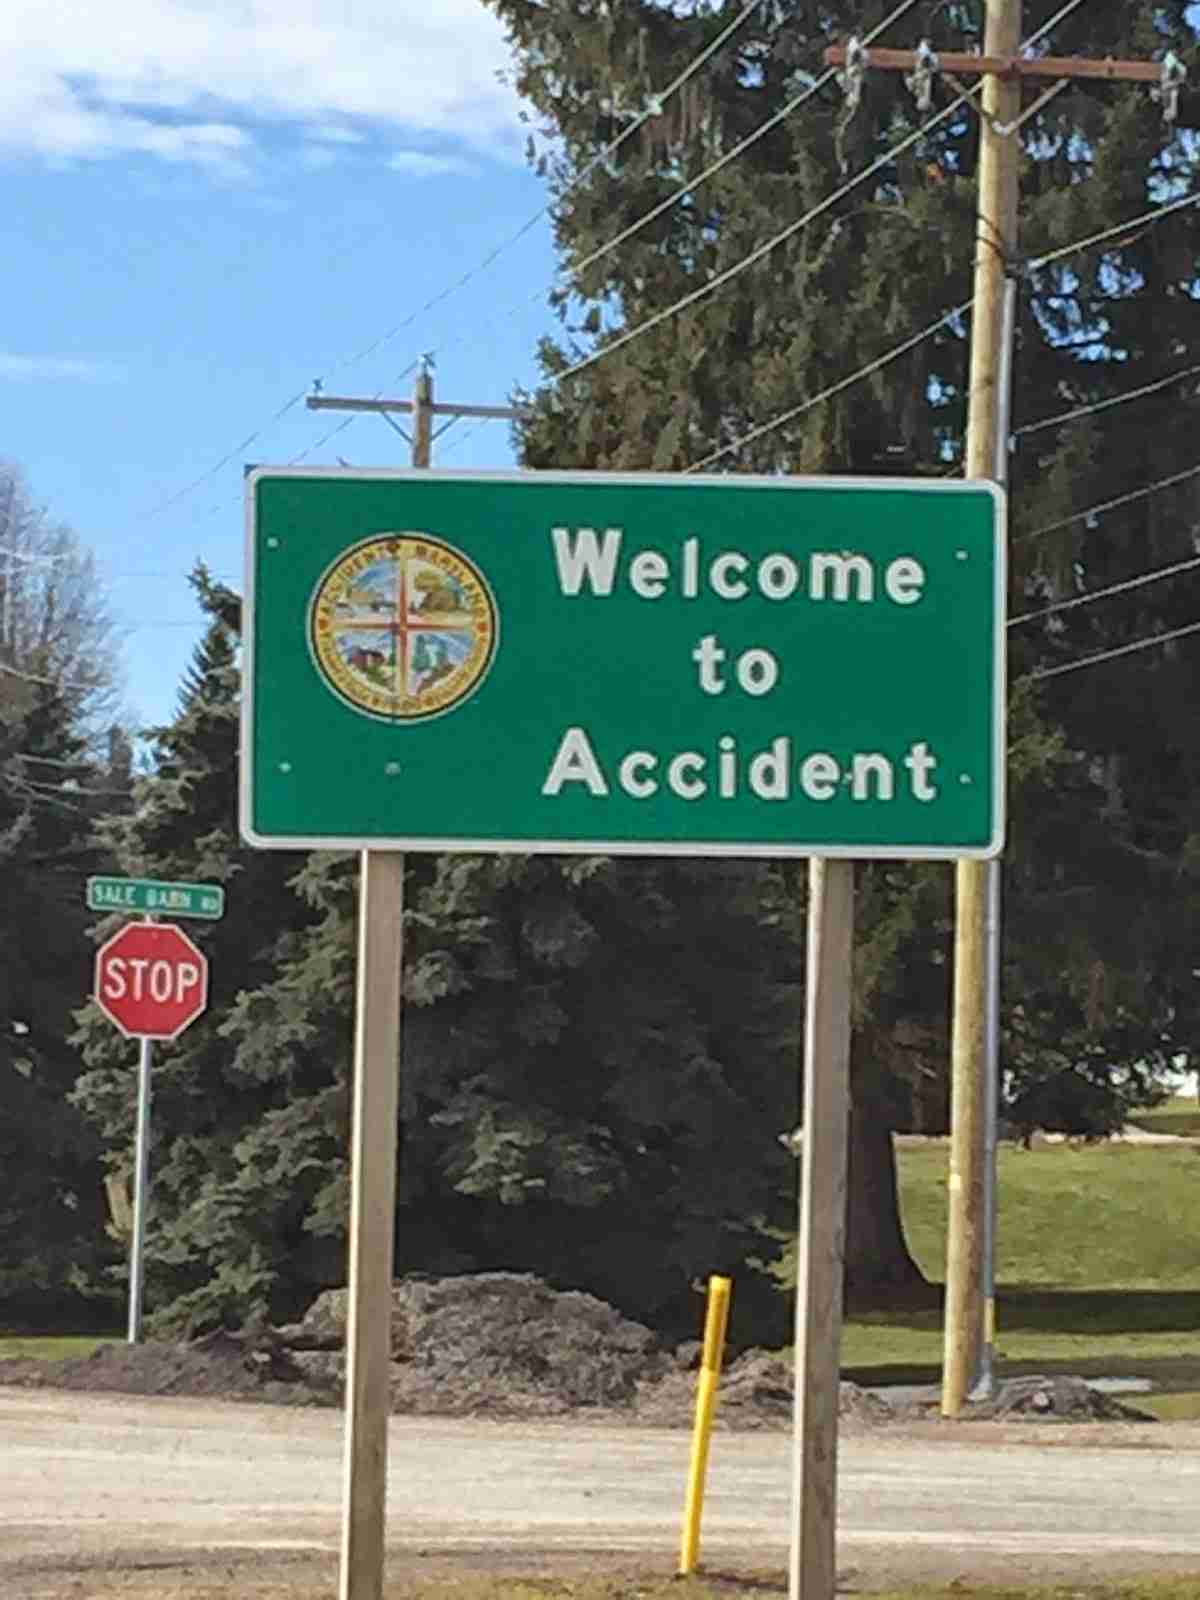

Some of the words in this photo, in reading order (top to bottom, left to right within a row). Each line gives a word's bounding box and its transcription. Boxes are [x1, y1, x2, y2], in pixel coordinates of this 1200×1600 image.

[552, 528, 925, 604] Welcome
[693, 636, 778, 696] to
[542, 728, 936, 802] Accident
[94, 885, 136, 906] SALE
[104, 957, 198, 1004] STOP
